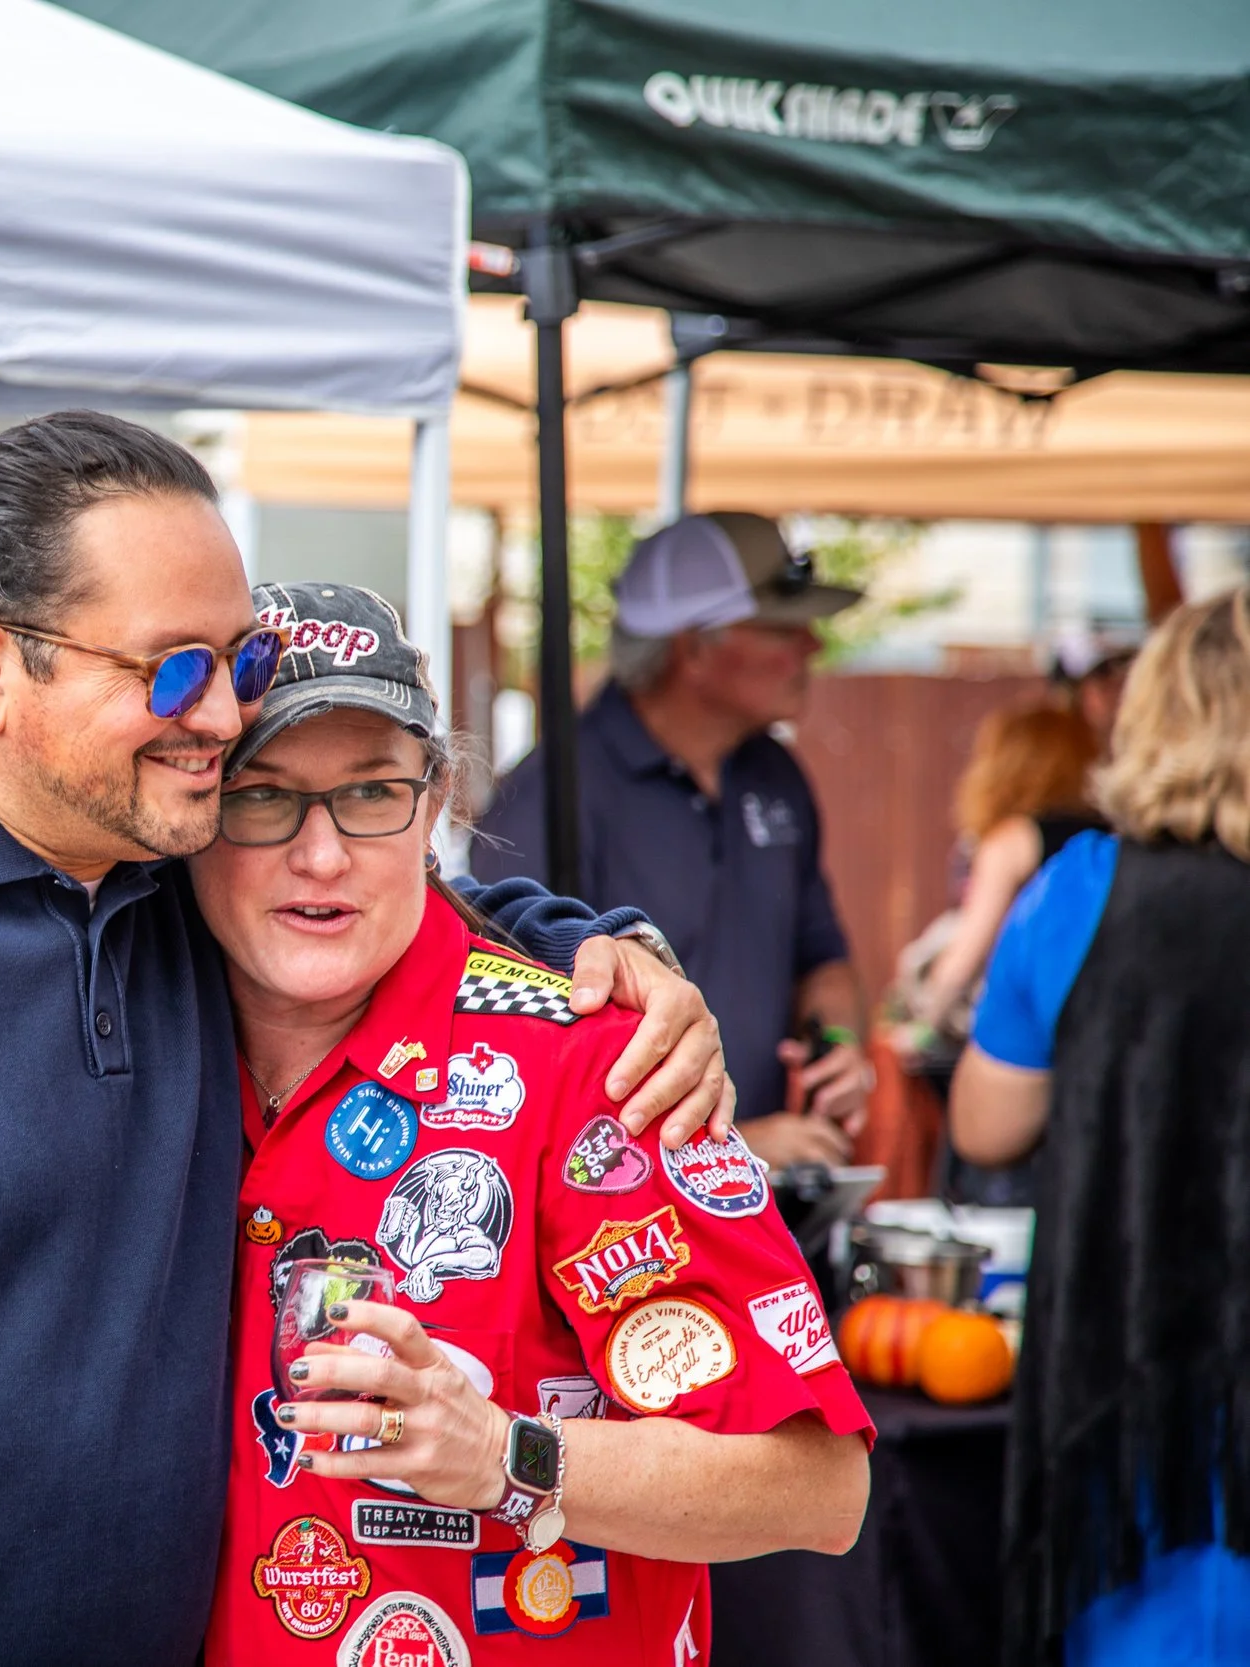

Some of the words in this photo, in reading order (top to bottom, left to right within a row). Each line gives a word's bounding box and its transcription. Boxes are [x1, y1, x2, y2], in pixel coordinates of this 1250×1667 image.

[447, 1072, 504, 1097] Shiner
[347, 1105, 391, 1155] Hi
[357, 1088, 384, 1101] SIGN
[386, 1098, 410, 1147] BREWING
[598, 1123, 614, 1138] I
[331, 1122, 352, 1160] AUSTIN
[591, 1134, 614, 1160] MY
[575, 1138, 606, 1179] DOG
[574, 1222, 677, 1303] NOLA
[609, 1265, 646, 1292] BREWING
[753, 1296, 779, 1311] NEW
[625, 1312, 653, 1337] CHRIS
[655, 1307, 715, 1337] VINEYARDS
[619, 1341, 637, 1388] WILLIAM
[707, 1361, 722, 1377] TEX
[362, 1508, 427, 1524] TREATY
[436, 1514, 469, 1528] OAK
[264, 1566, 360, 1586] Wurstfest
[281, 1601, 294, 1619] NEW
[290, 1617, 333, 1633] BRAUNFELS
[415, 1606, 438, 1629] SPRING
[381, 1628, 407, 1640] SINCE
[374, 1637, 435, 1667] Pearl
